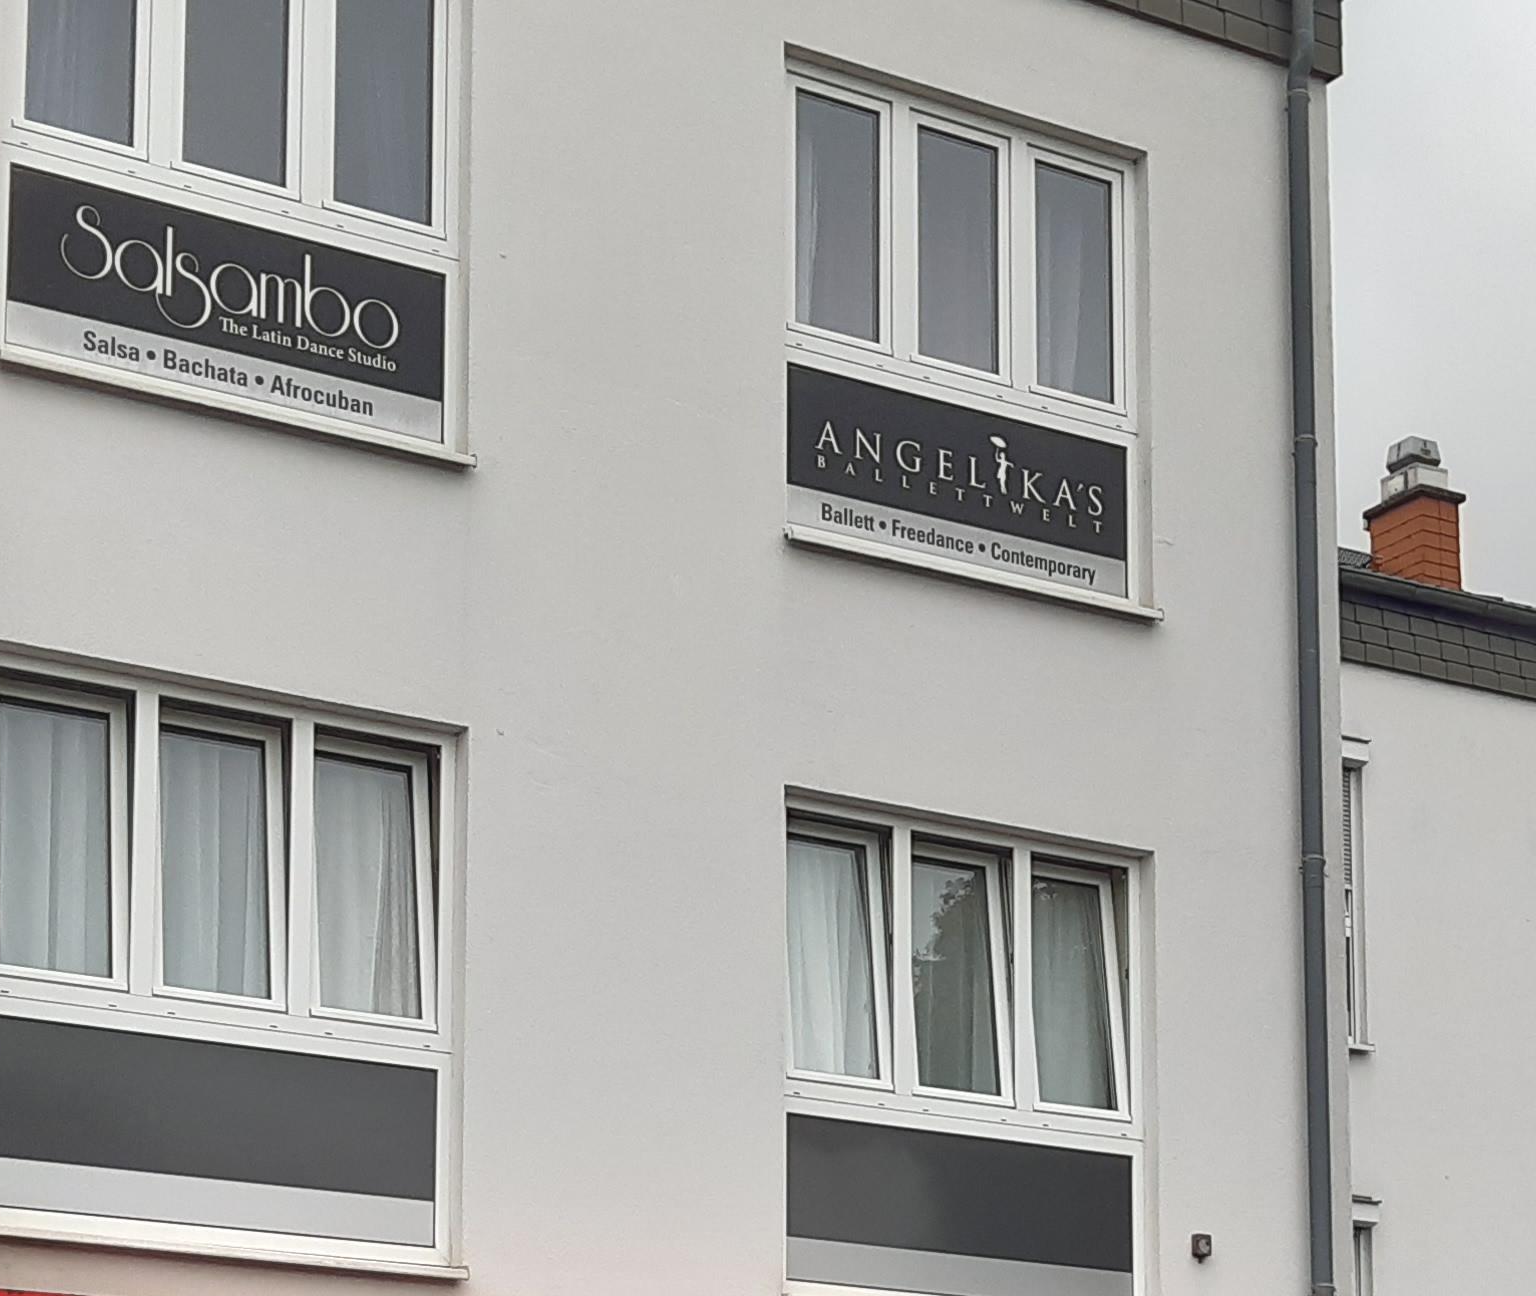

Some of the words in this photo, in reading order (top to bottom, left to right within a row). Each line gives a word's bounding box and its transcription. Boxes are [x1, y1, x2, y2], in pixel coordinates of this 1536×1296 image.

[60, 205, 399, 349] Salsambo
[83, 330, 141, 363] Salsa
[163, 350, 249, 388] Bachata
[270, 375, 374, 417] Afrocuban
[219, 315, 248, 338] The
[252, 323, 292, 348] Latin
[297, 335, 344, 362] Dance
[348, 346, 397, 372] Studio
[817, 455, 1103, 534] BALLETTWELT
[821, 503, 875, 532] Ballett
[892, 519, 974, 555] Freedance
[991, 542, 1096, 585] Contemporary
